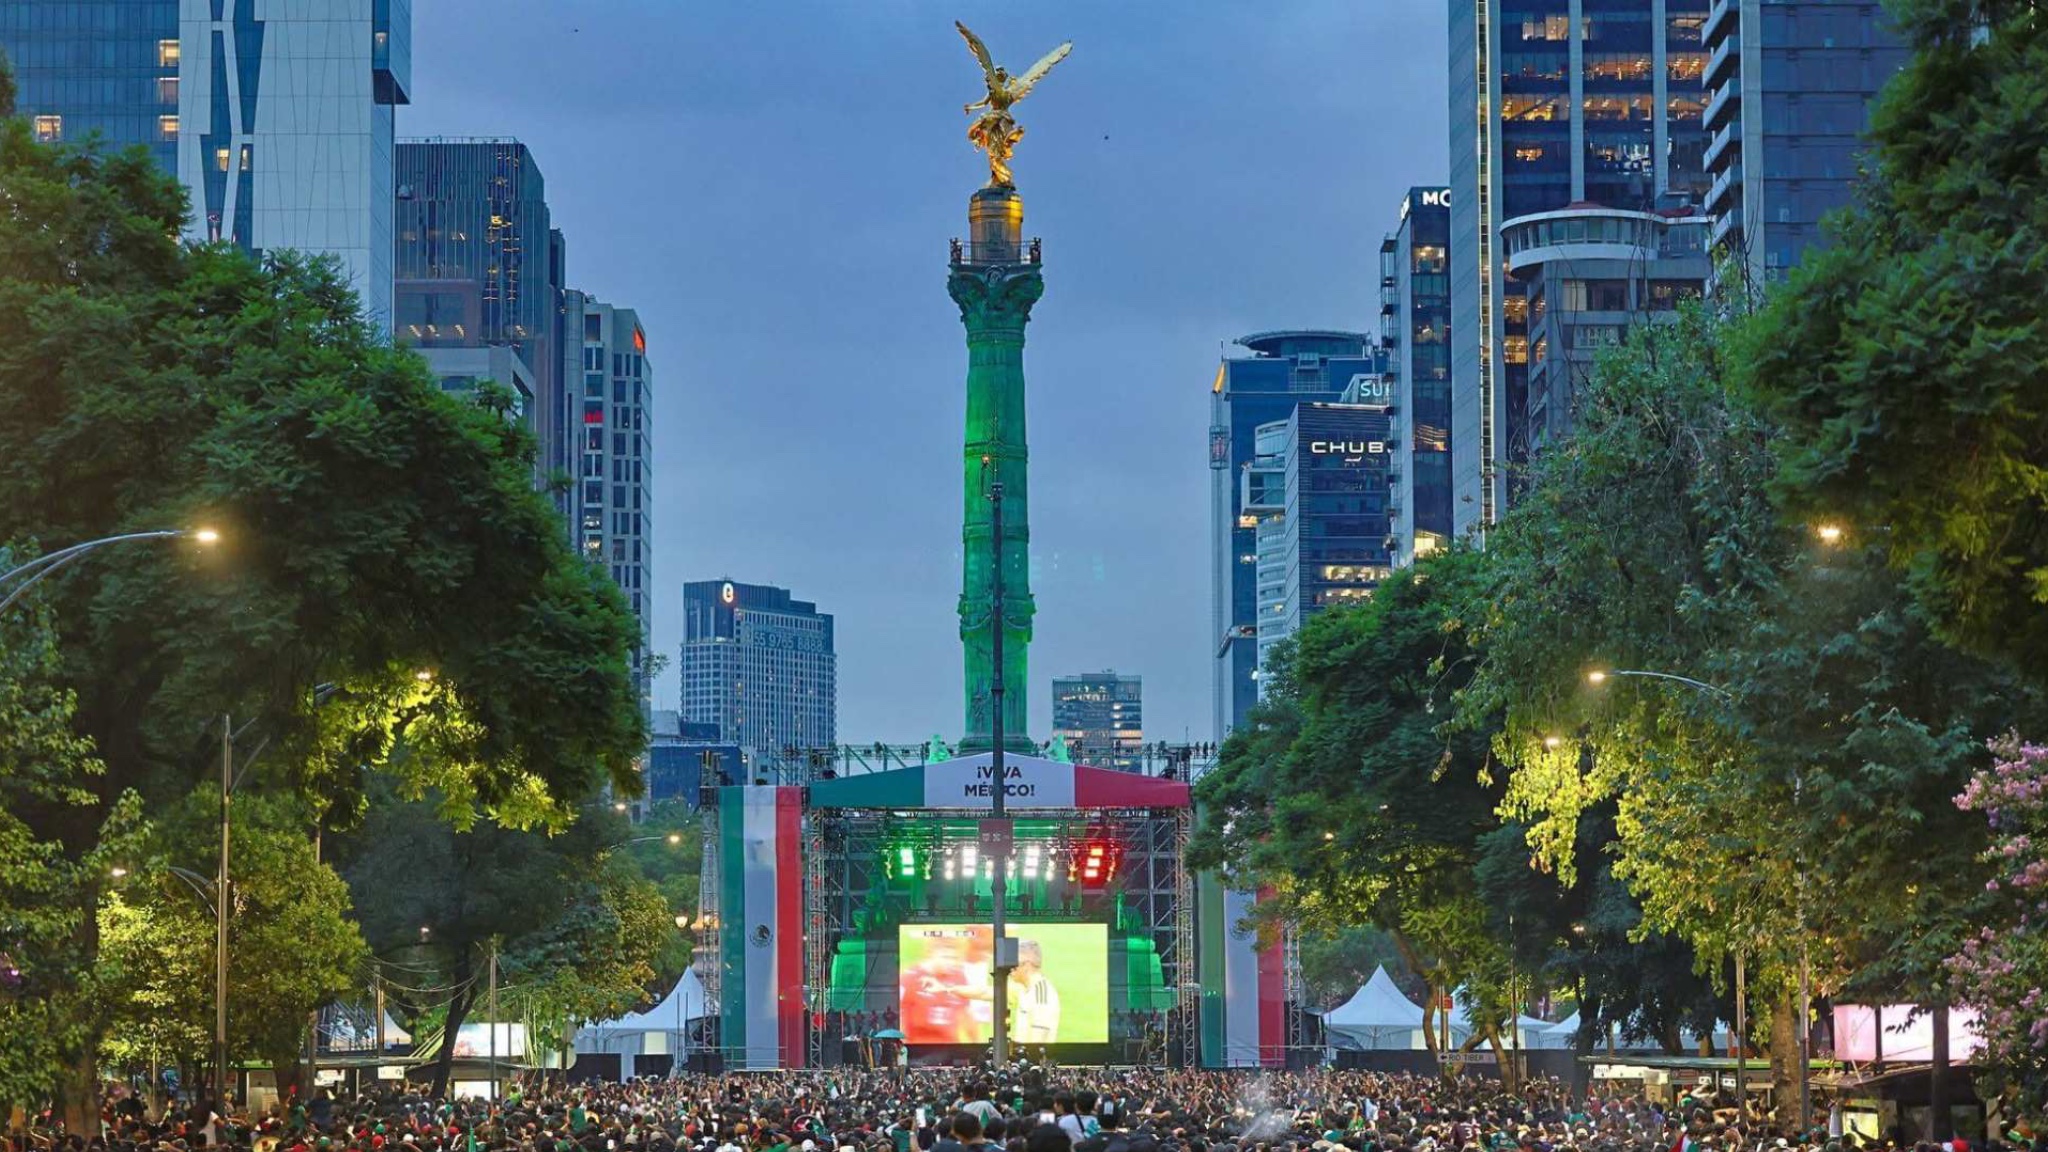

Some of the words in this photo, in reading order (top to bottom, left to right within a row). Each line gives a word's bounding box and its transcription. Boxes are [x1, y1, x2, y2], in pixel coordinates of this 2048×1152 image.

[1311, 441, 1392, 454] CHUB
[977, 766, 1022, 779] ¡VVA
[964, 781, 1035, 797] MÉCO!
